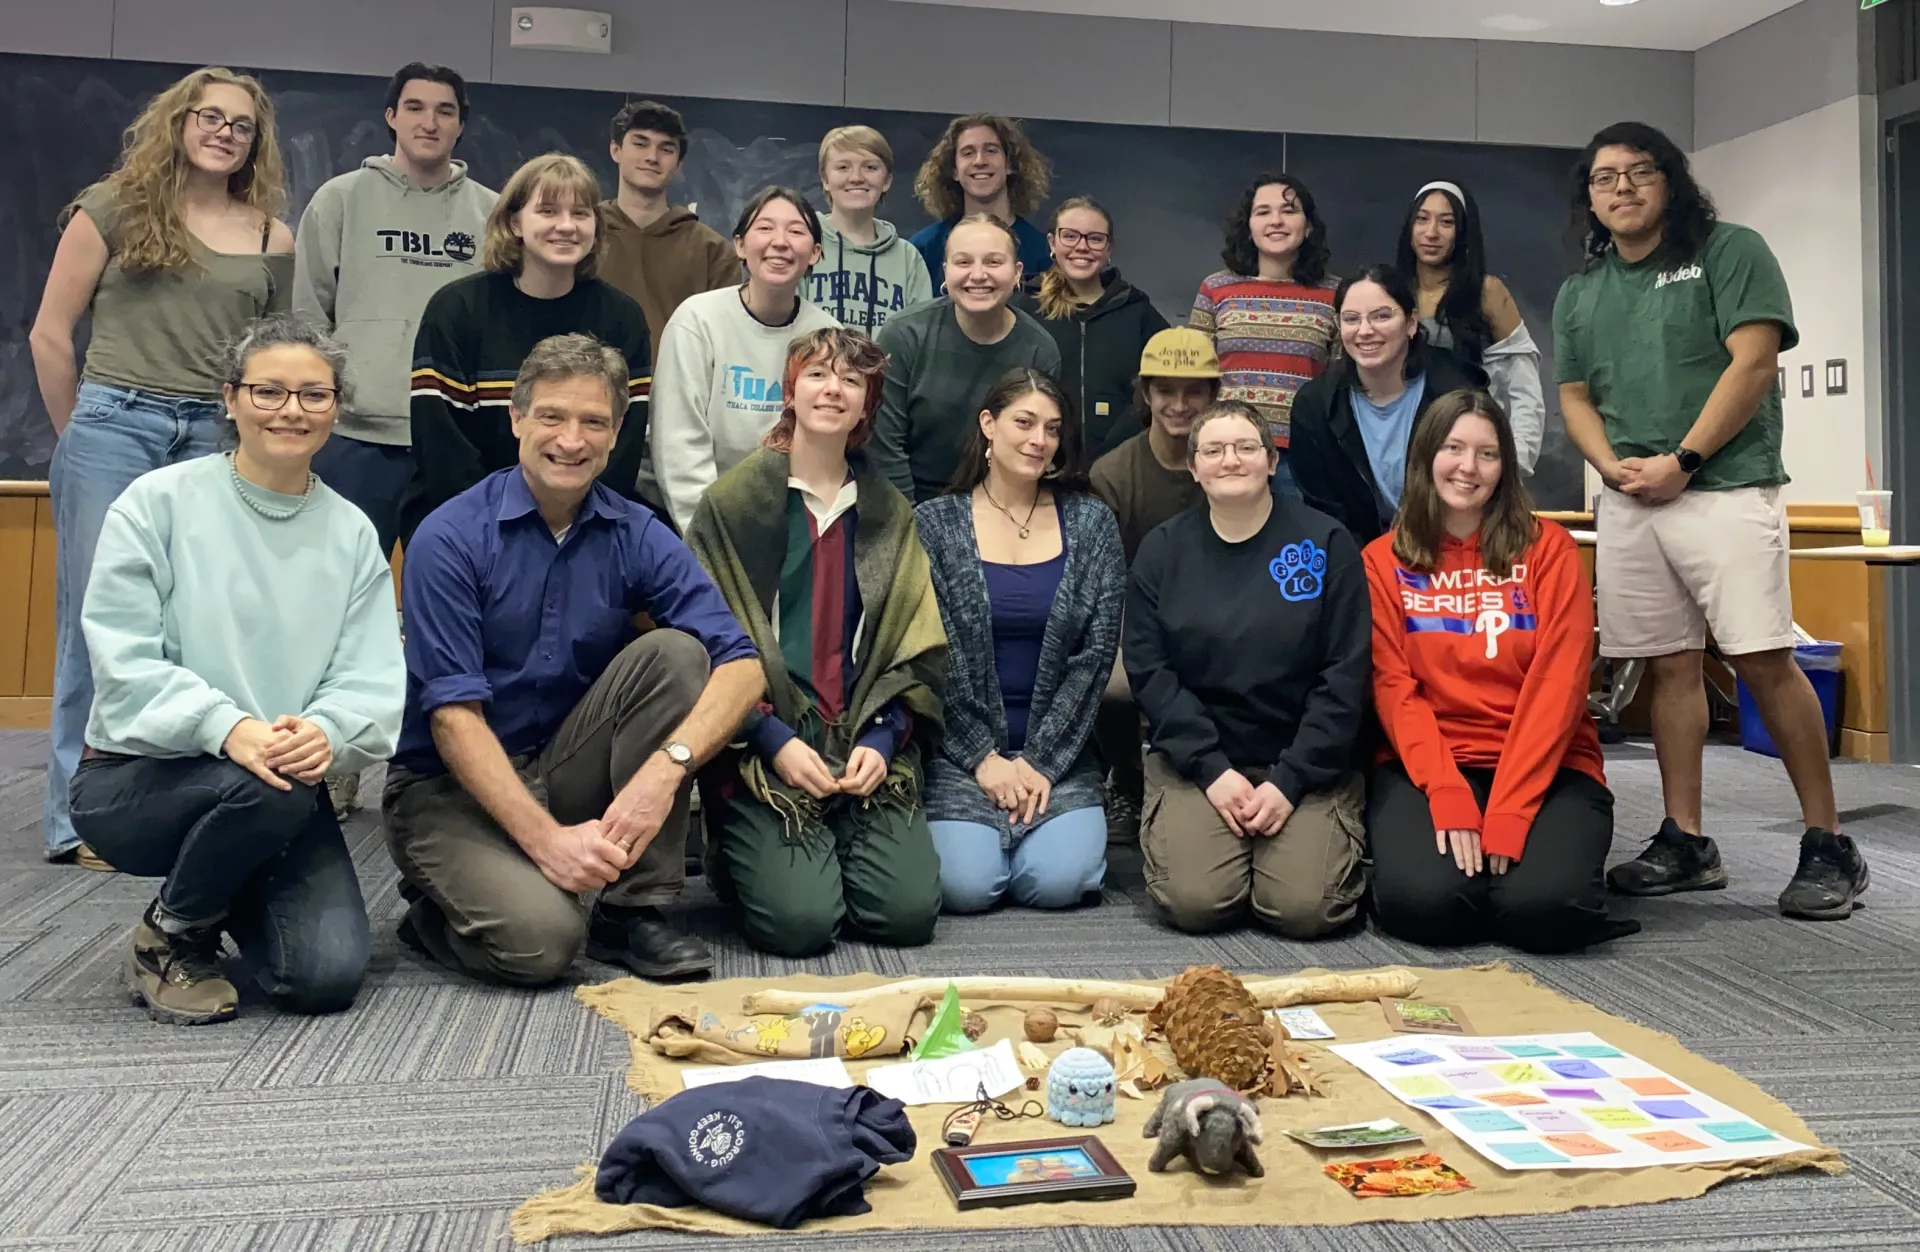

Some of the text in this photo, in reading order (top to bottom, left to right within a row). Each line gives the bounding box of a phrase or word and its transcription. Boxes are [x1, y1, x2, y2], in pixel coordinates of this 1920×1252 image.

[376, 230, 444, 256] TBL
[810, 270, 905, 312] THACA
[1174, 357, 1196, 370] pile
[1190, 349, 1200, 357] in
[726, 401, 748, 410] ITHACA
[1292, 575, 1313, 593] IC
[1400, 590, 1504, 614] SERIES
[688, 1111, 721, 1162] KEEP GOING
